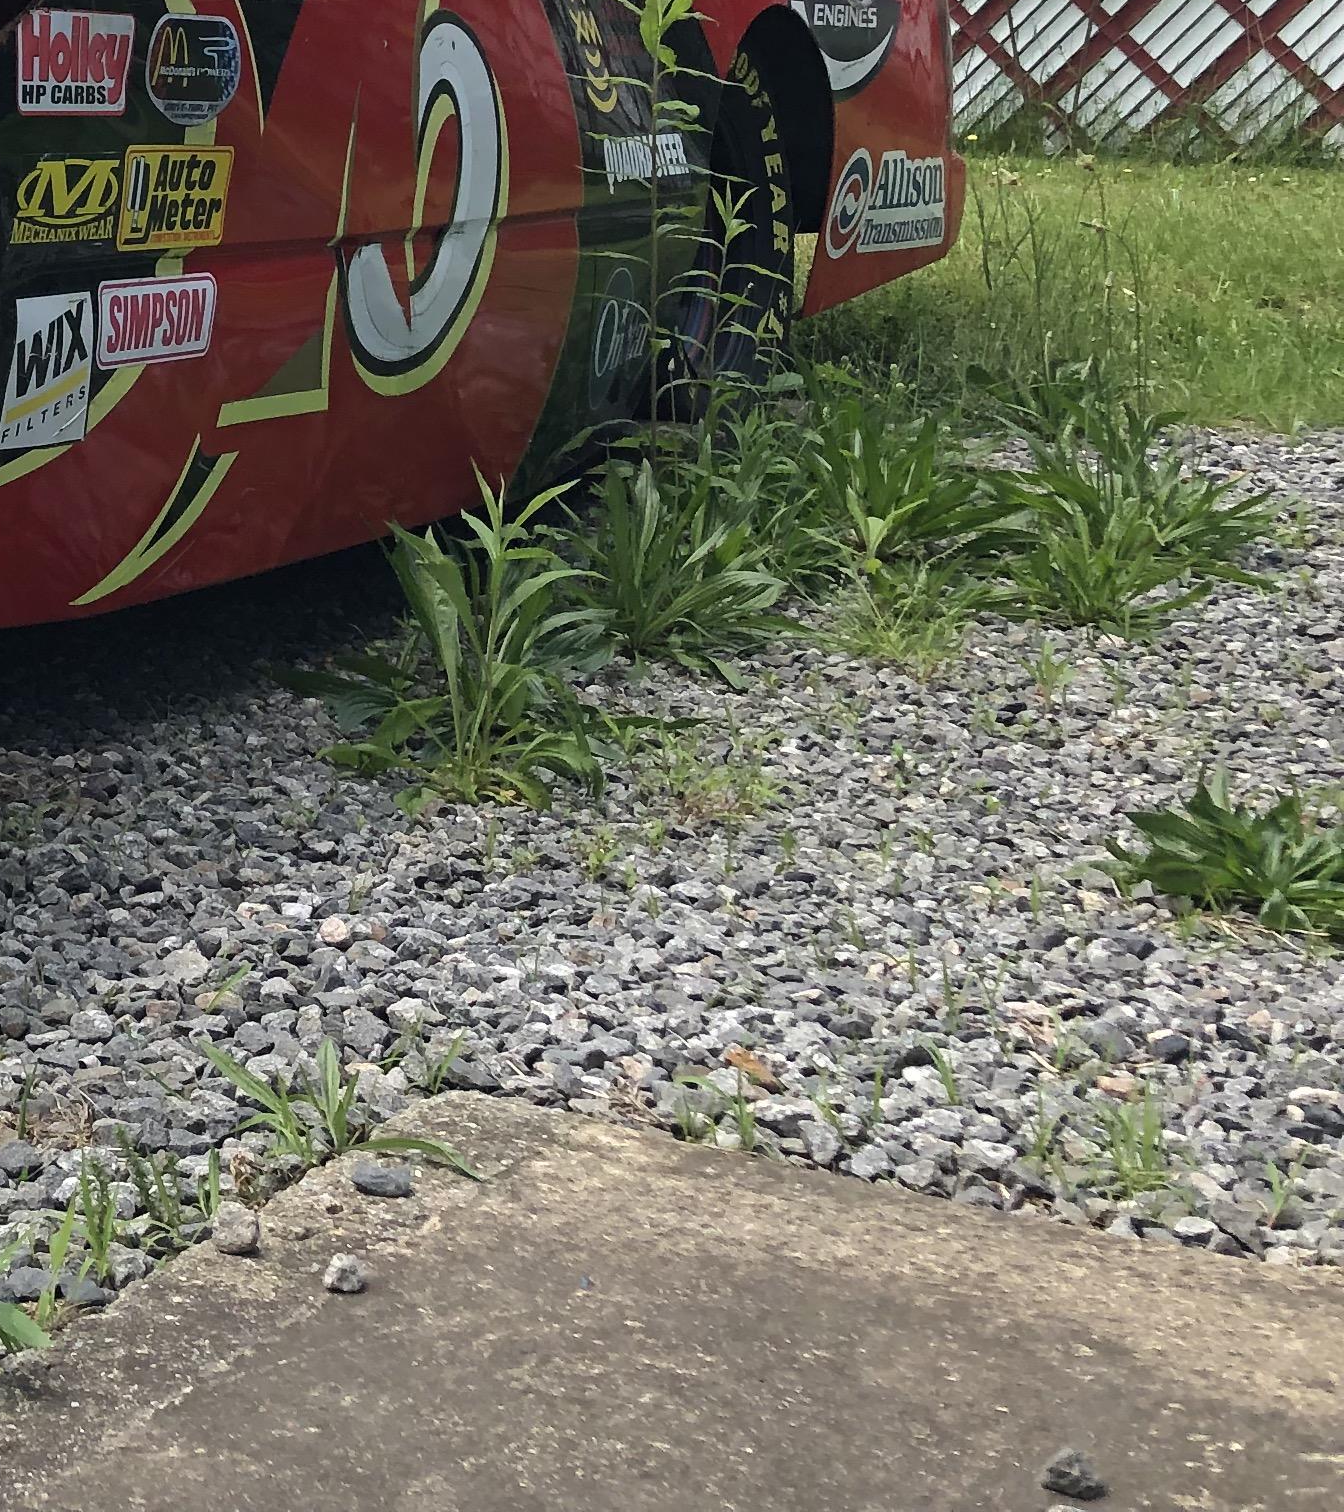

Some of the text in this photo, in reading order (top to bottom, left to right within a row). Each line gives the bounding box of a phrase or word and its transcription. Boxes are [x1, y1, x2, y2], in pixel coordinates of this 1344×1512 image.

[813, 3, 879, 30] ENGINES
[18, 14, 130, 104] Holley
[21, 85, 107, 105] HP CARBS
[153, 154, 216, 192] Auto
[868, 152, 944, 209] Allison
[10, 216, 113, 244] MECHANIX WEAR
[146, 193, 222, 232] Meter
[861, 216, 943, 245] Transmission
[106, 288, 207, 355] SIMPSON
[16, 298, 88, 399] WIX
[0, 386, 86, 445] FILTERS
